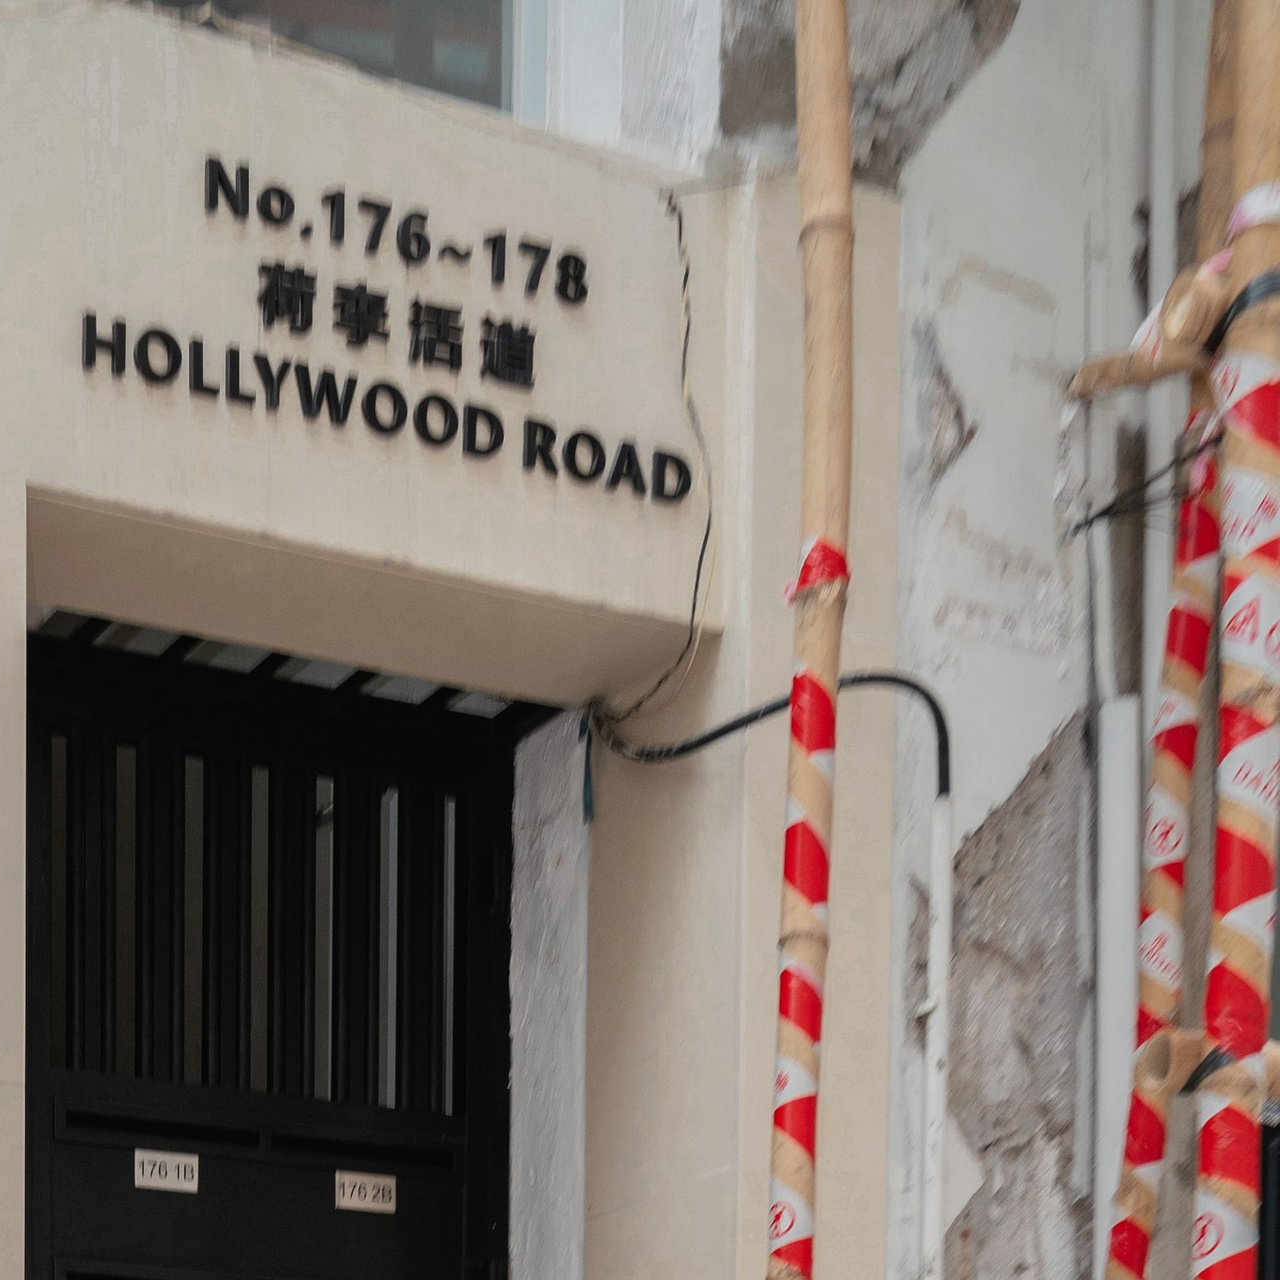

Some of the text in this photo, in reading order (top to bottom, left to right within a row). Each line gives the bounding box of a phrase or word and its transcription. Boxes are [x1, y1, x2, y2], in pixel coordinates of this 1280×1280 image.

[203, 155, 590, 309] No.176~178
[256, 260, 537, 389] 荷李活道
[80, 312, 693, 505] HOLLYWOOD ROAD
[139, 1159, 194, 1182] 176 1B
[340, 1180, 367, 1201] 176
